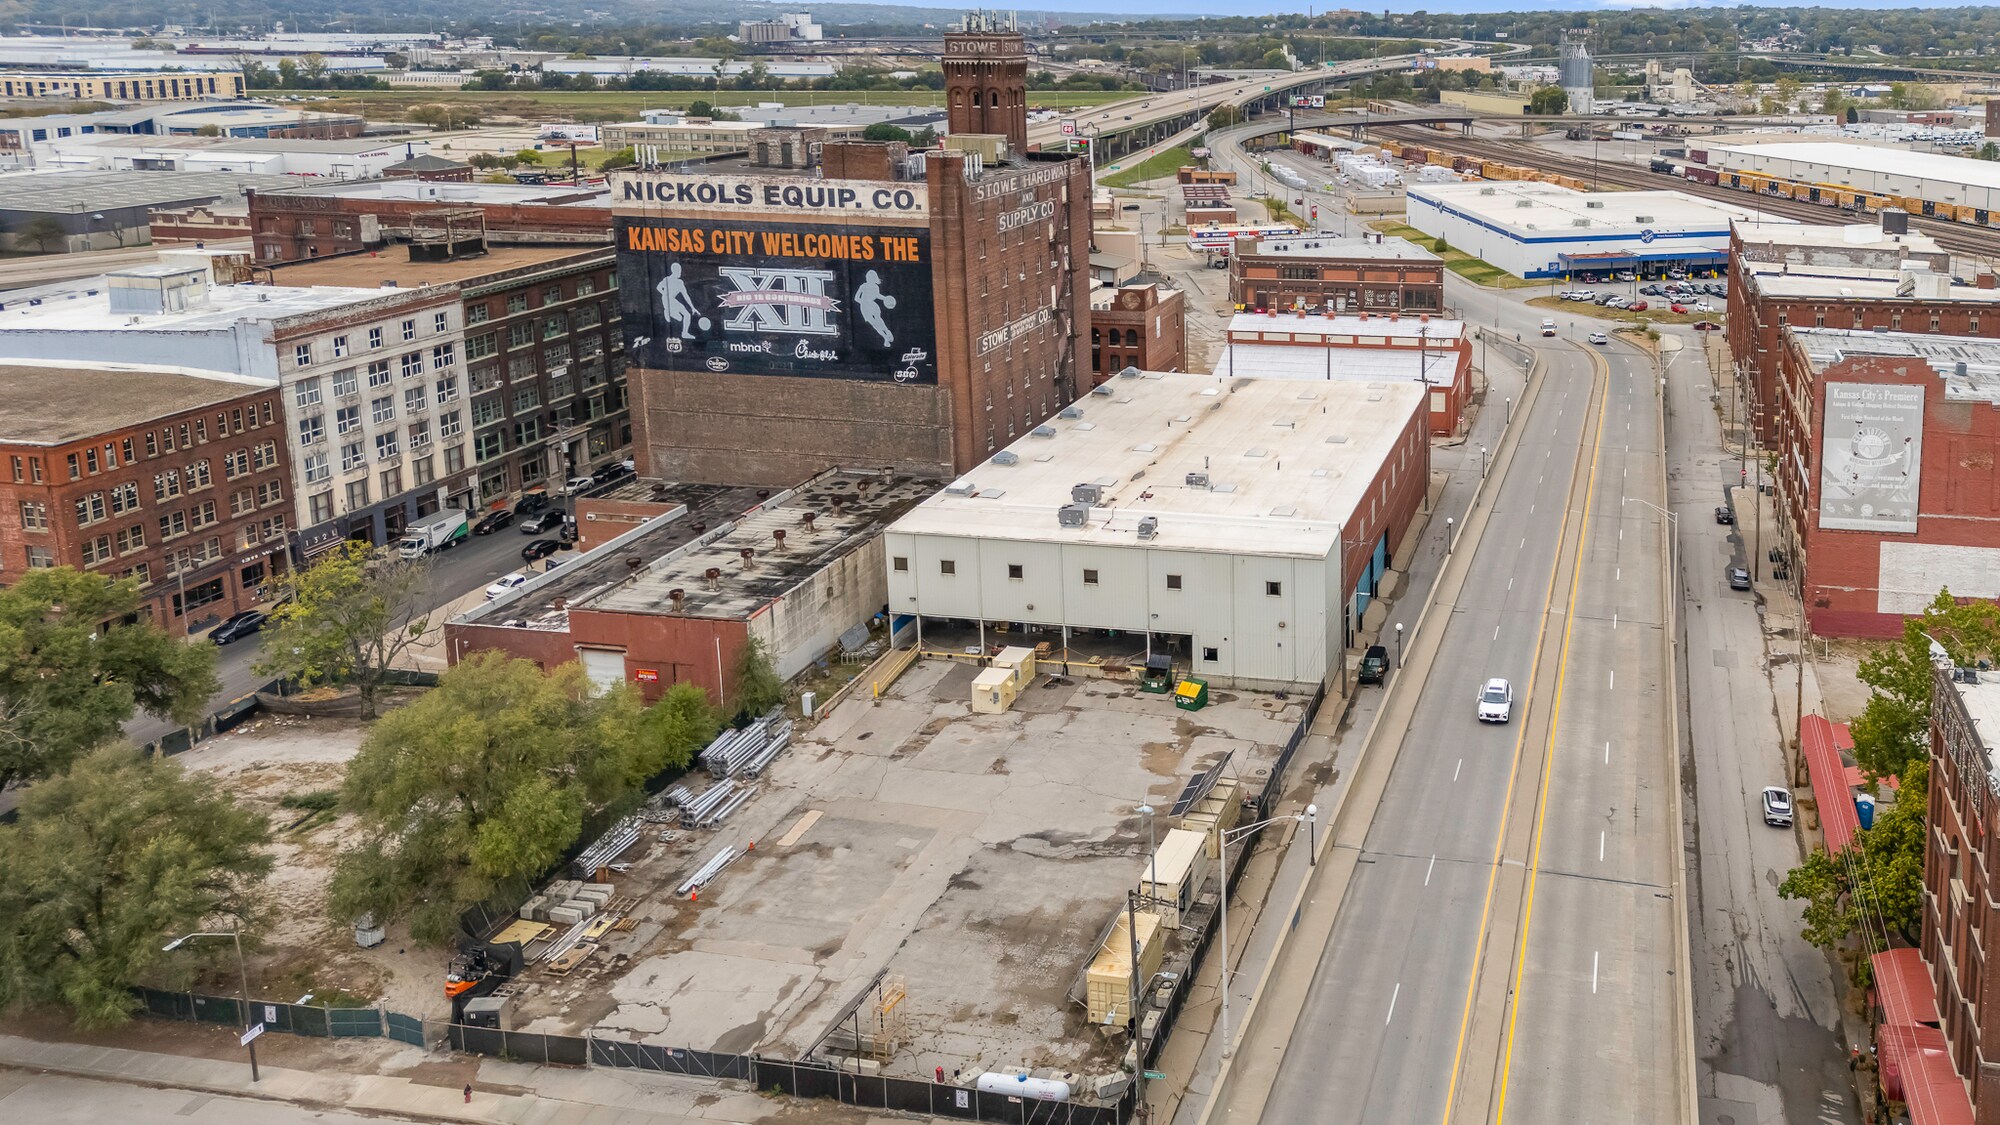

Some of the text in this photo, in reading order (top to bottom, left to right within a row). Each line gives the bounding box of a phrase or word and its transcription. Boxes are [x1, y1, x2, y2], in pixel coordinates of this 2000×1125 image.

[949, 41, 997, 53] STOWE
[623, 181, 922, 210] NICKOLS EQUIP. CO.
[977, 177, 1018, 200] STOWE
[1022, 191, 1034, 203] AND
[999, 201, 1055, 231] SUPPLY CO
[628, 226, 920, 262] KANSAS CITY WELCOMES THE
[718, 265, 838, 336] XII
[736, 294, 752, 302] BIG
[765, 293, 821, 306] CONFERENCE
[982, 327, 1009, 351] STOWE
[1038, 308, 1051, 324] CO.
[730, 341, 762, 353] mbna
[896, 370, 916, 379] SBC
[1833, 388, 1919, 402] Kansas City's Premiere
